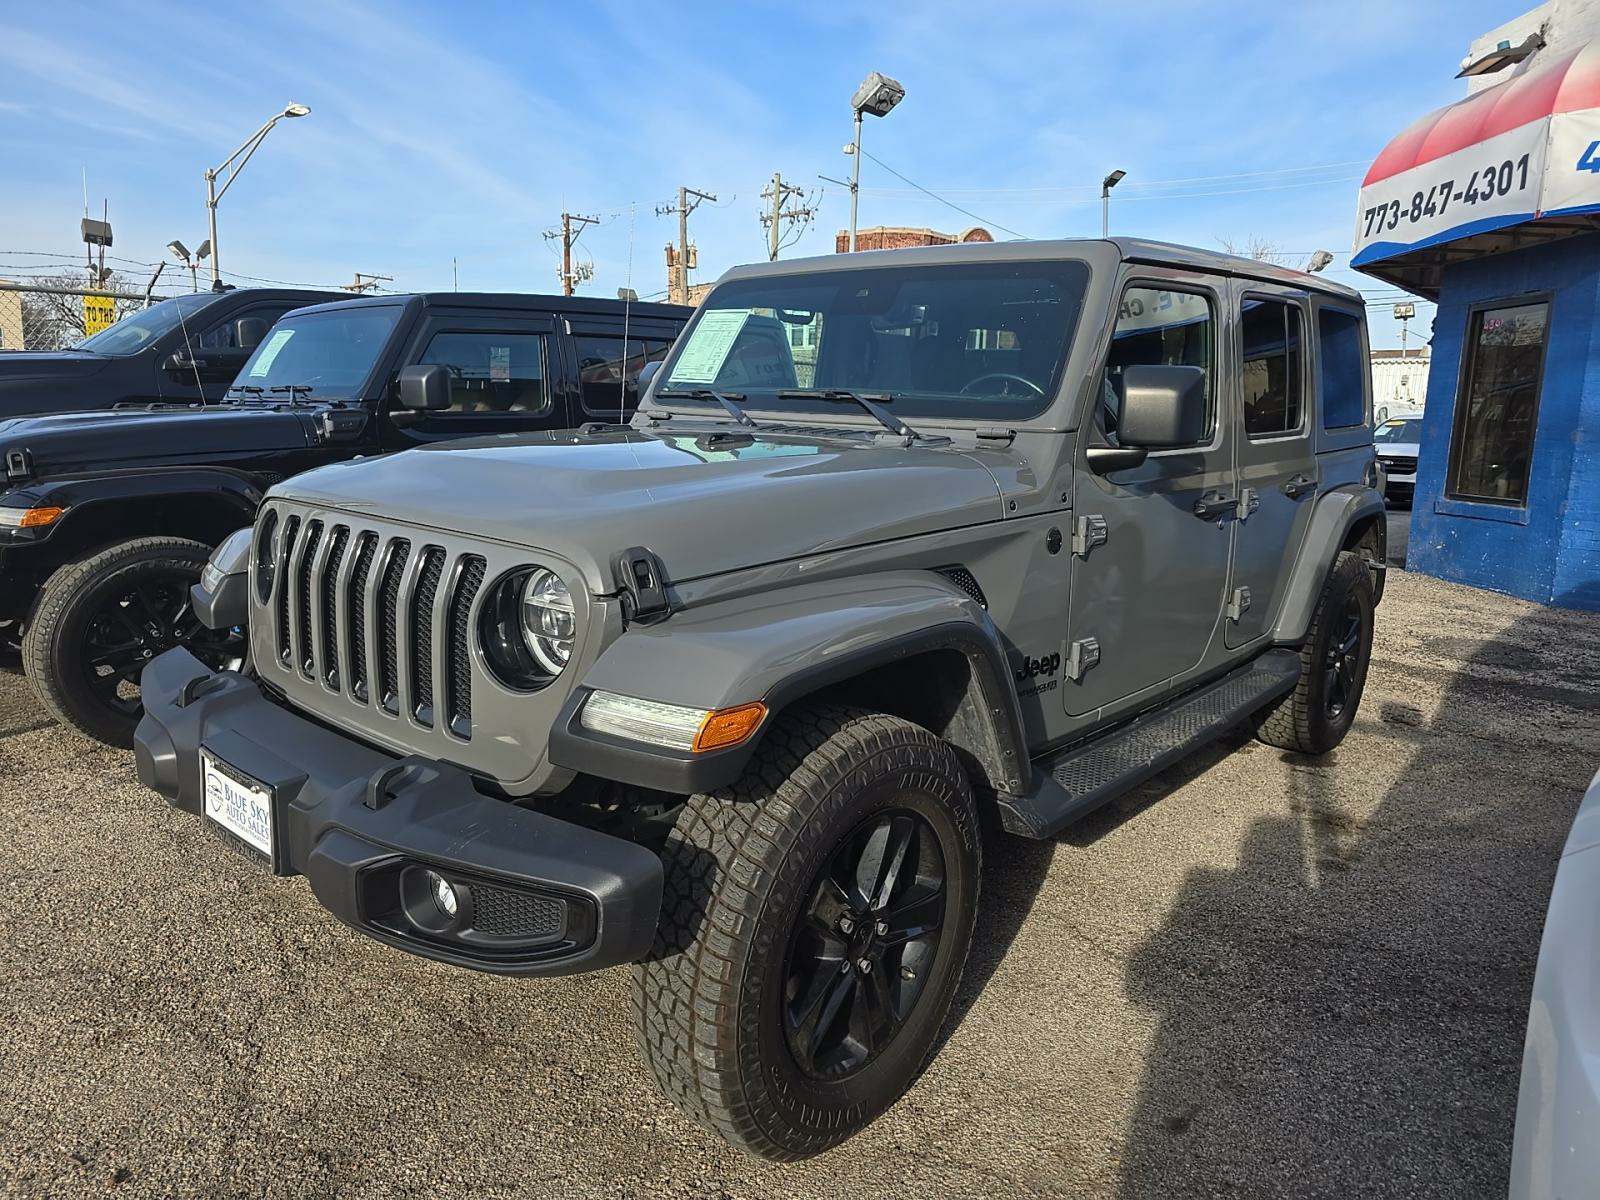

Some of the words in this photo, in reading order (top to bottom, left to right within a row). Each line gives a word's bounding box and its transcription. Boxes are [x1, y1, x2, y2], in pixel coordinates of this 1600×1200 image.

[1364, 153, 1530, 238] 773-847-4301
[86, 306, 97, 322] TO
[98, 307, 114, 323] THE
[1016, 651, 1060, 681] Jeep
[224, 783, 248, 813] BLUE
[250, 800, 269, 825] SKY
[226, 803, 246, 825] AUTO
[247, 817, 269, 840] SALES
